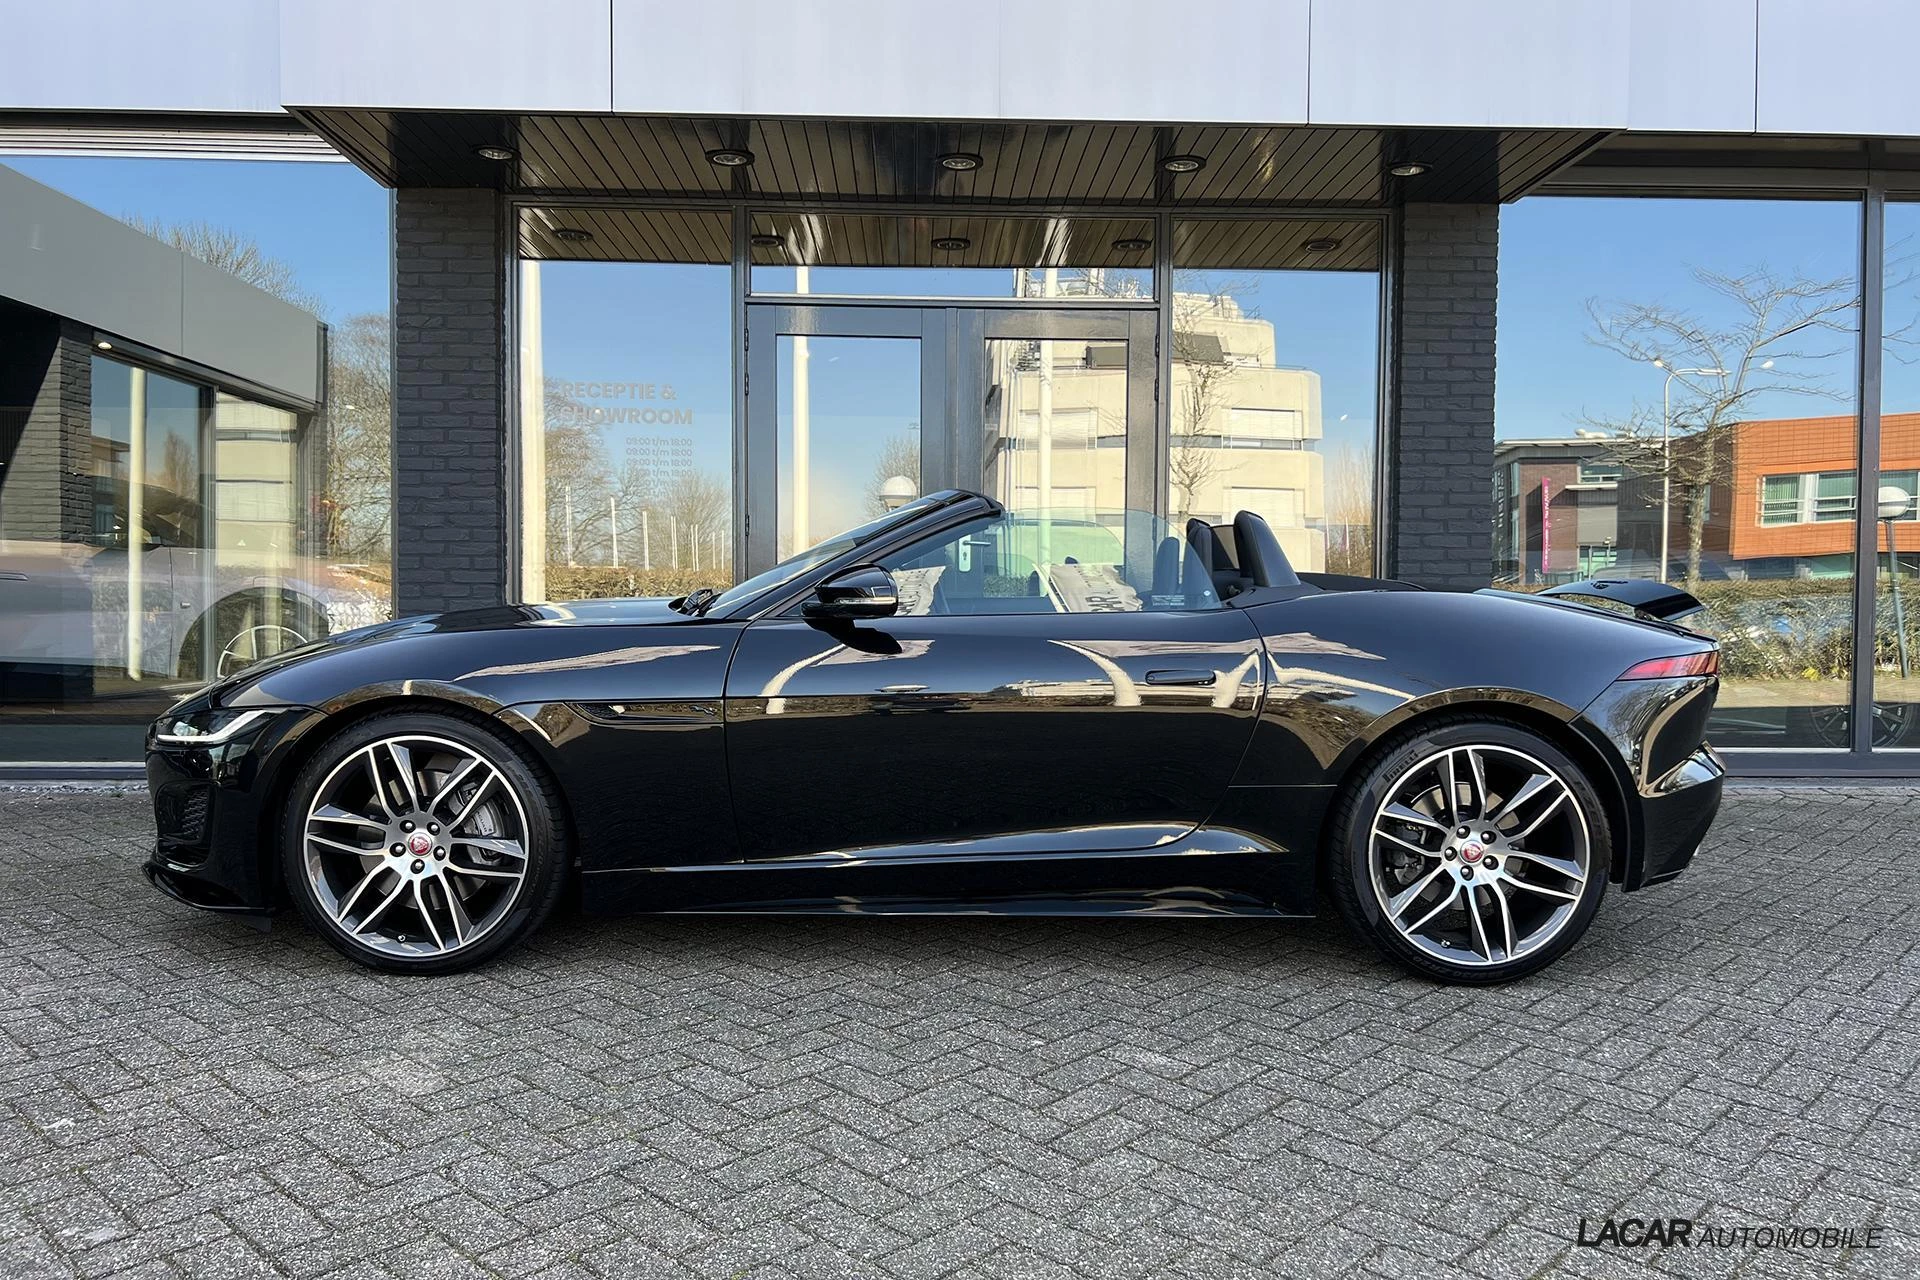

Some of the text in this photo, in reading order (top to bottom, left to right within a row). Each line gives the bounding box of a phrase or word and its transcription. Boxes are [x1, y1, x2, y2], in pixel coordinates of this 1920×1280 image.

[561, 382, 678, 400] RECEPTIE &
[561, 406, 693, 424] SHOWROOM
[1382, 749, 1419, 783] PIRELLI
